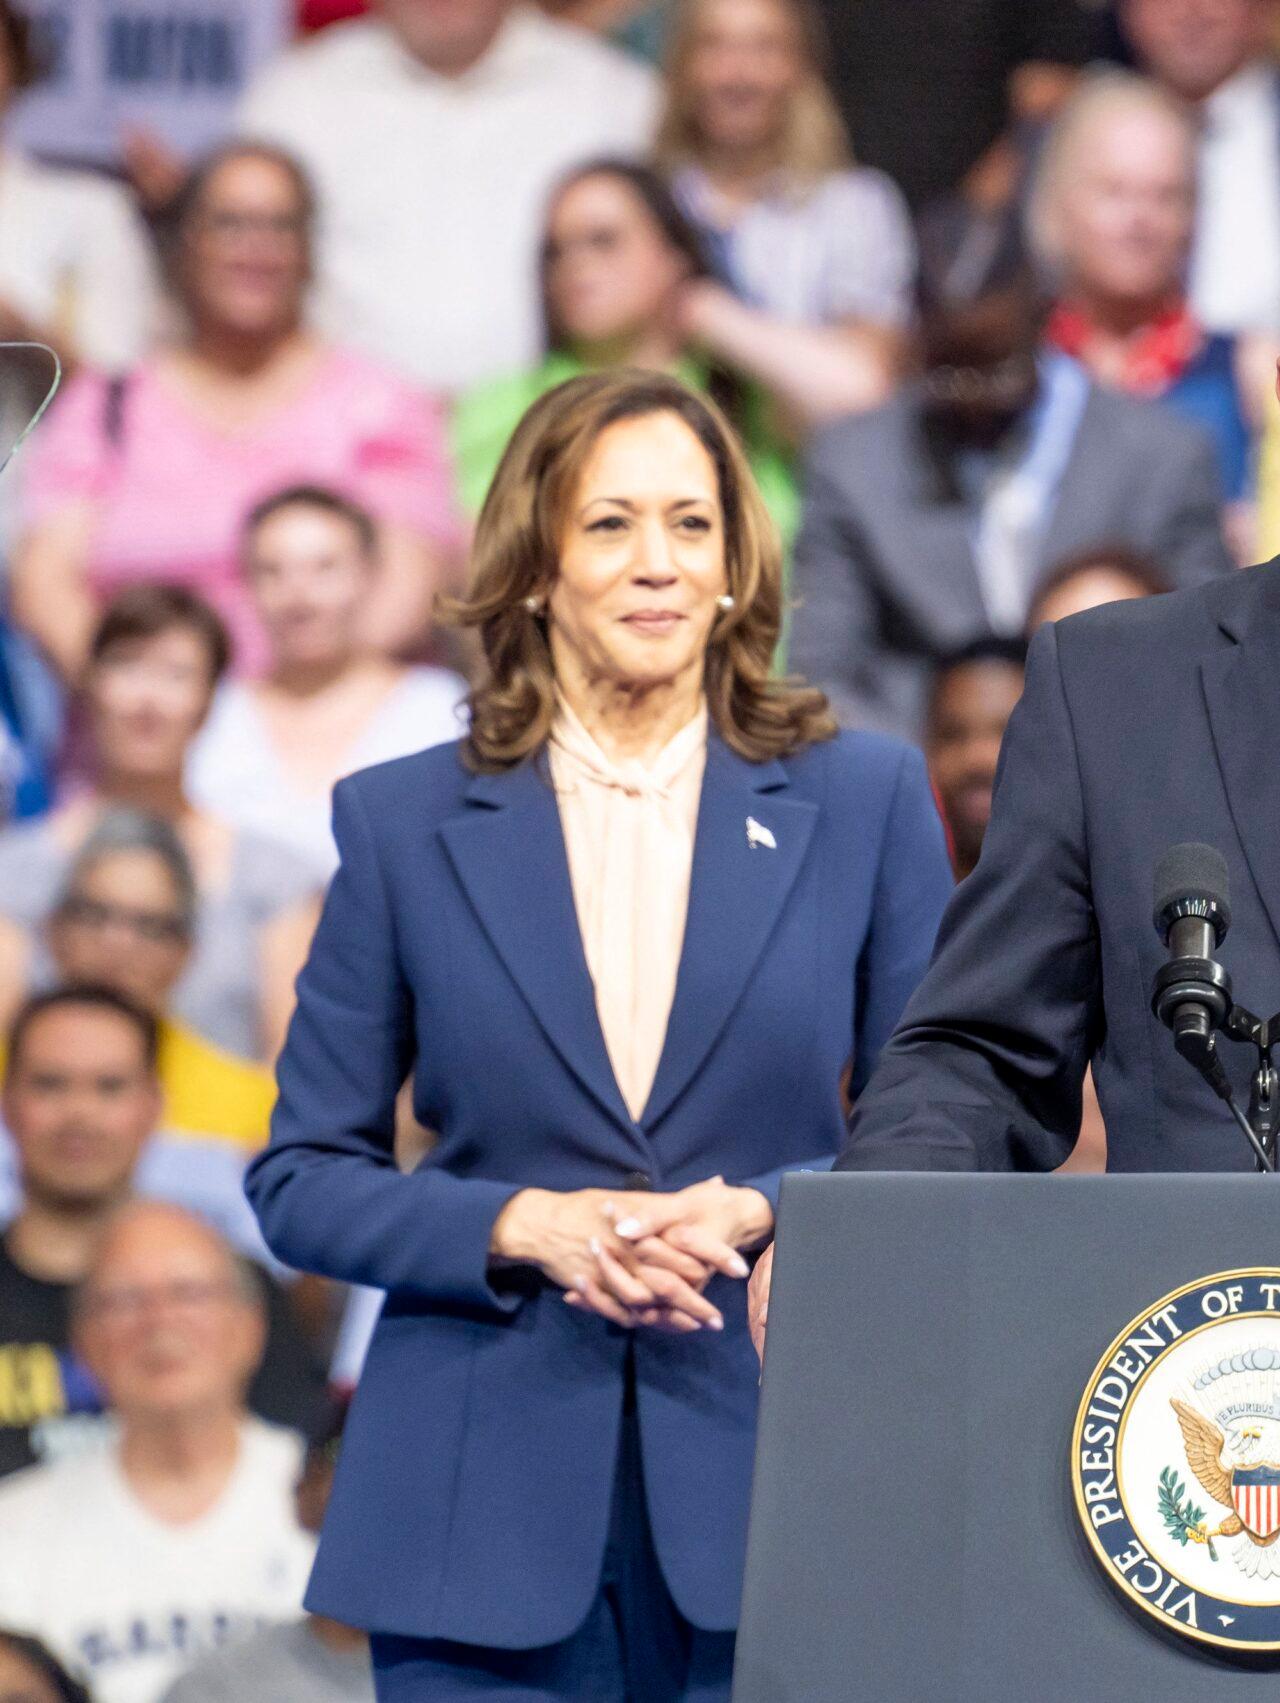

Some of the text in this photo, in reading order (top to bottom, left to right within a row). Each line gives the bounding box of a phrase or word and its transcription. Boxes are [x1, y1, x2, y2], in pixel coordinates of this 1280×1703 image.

[1201, 1286, 1245, 1318] OF
[1081, 1304, 1188, 1529] PRESIDENT
[1227, 1403, 1275, 1416] PLURIBUS
[1113, 1540, 1198, 1628] VICE
